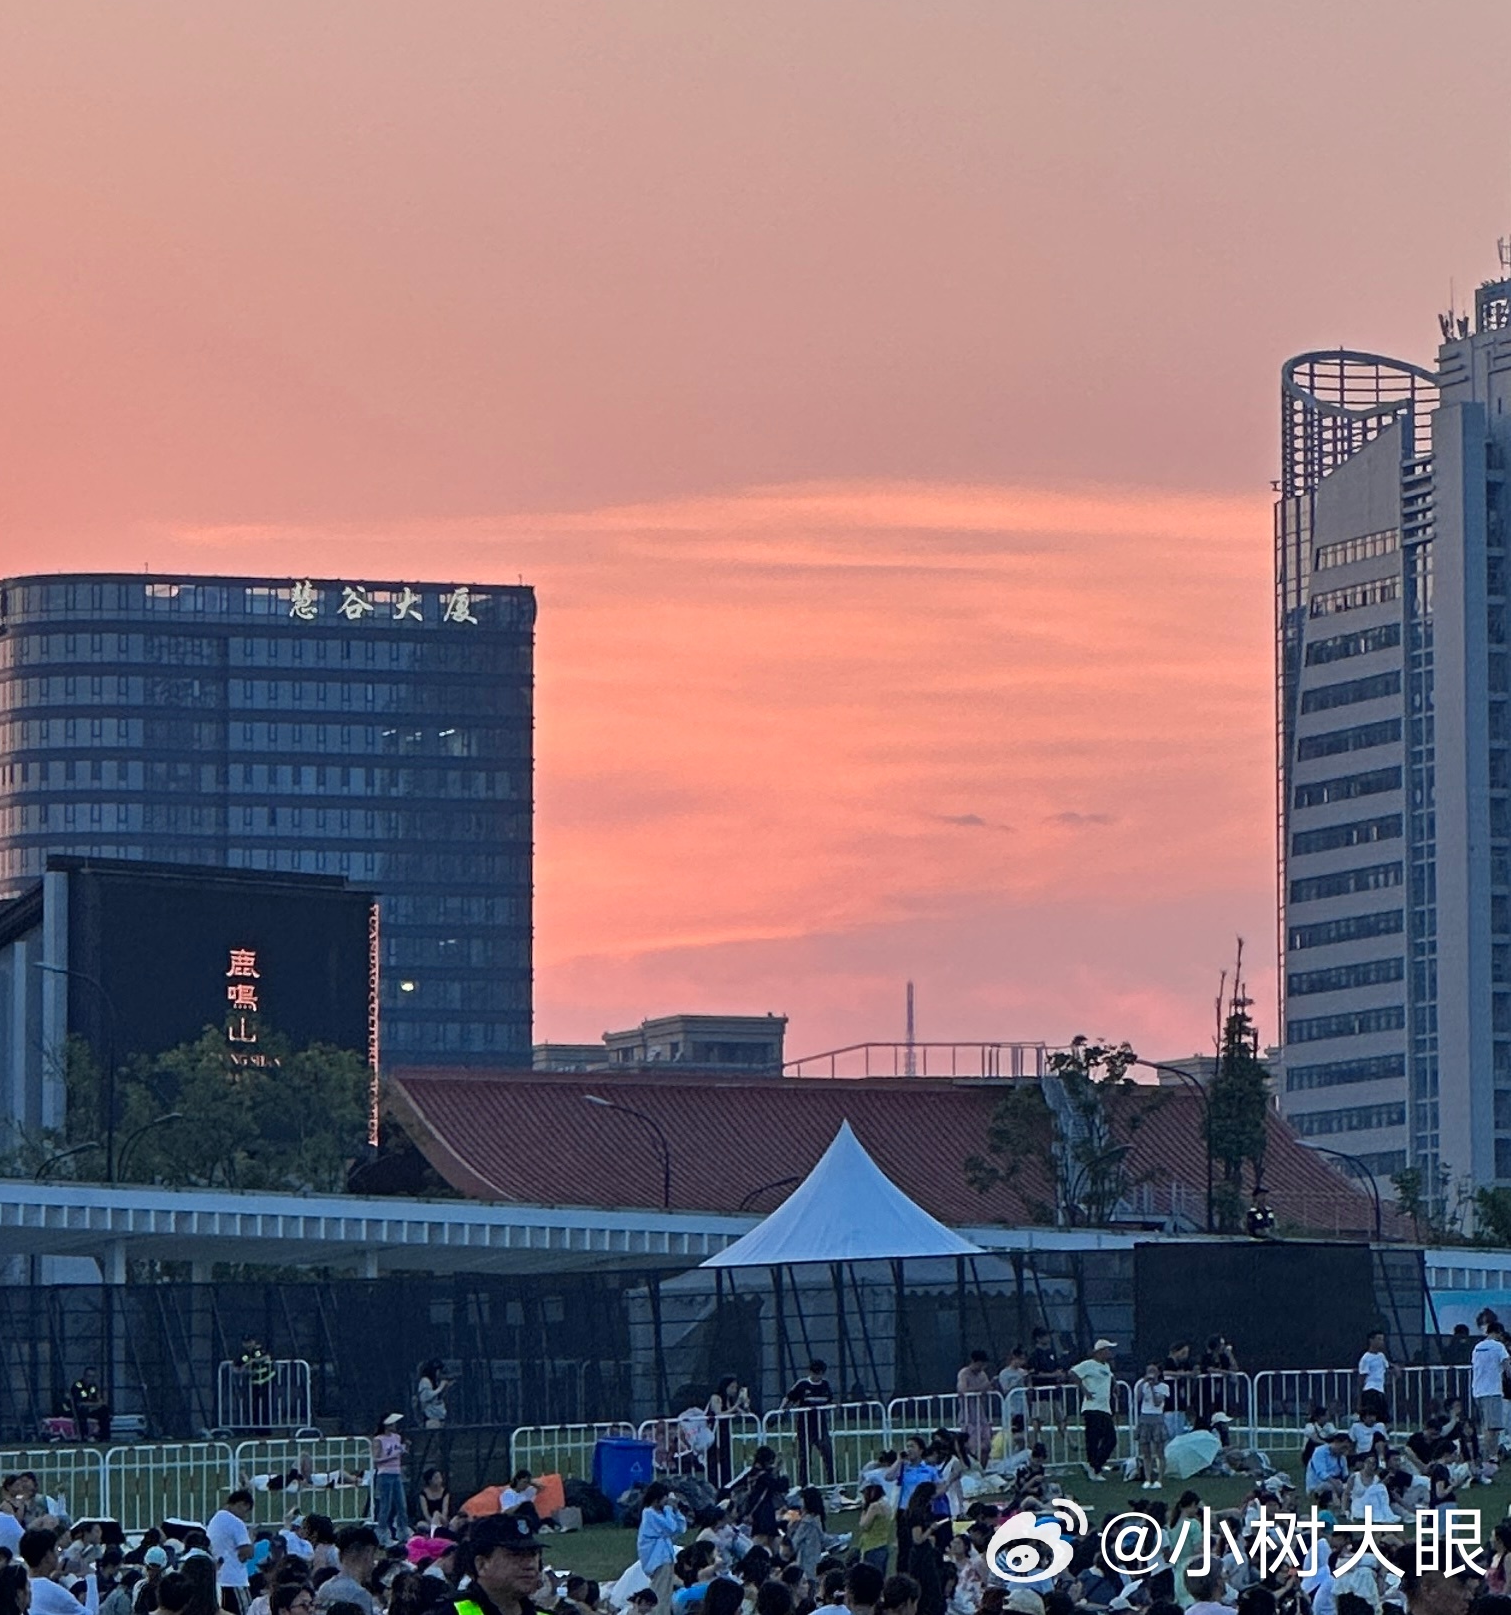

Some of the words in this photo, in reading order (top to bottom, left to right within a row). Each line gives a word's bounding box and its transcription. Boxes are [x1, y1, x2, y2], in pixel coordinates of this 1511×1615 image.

[290, 580, 478, 625] 慧谷大厦
[226, 948, 261, 1044] 鹿鳴山
